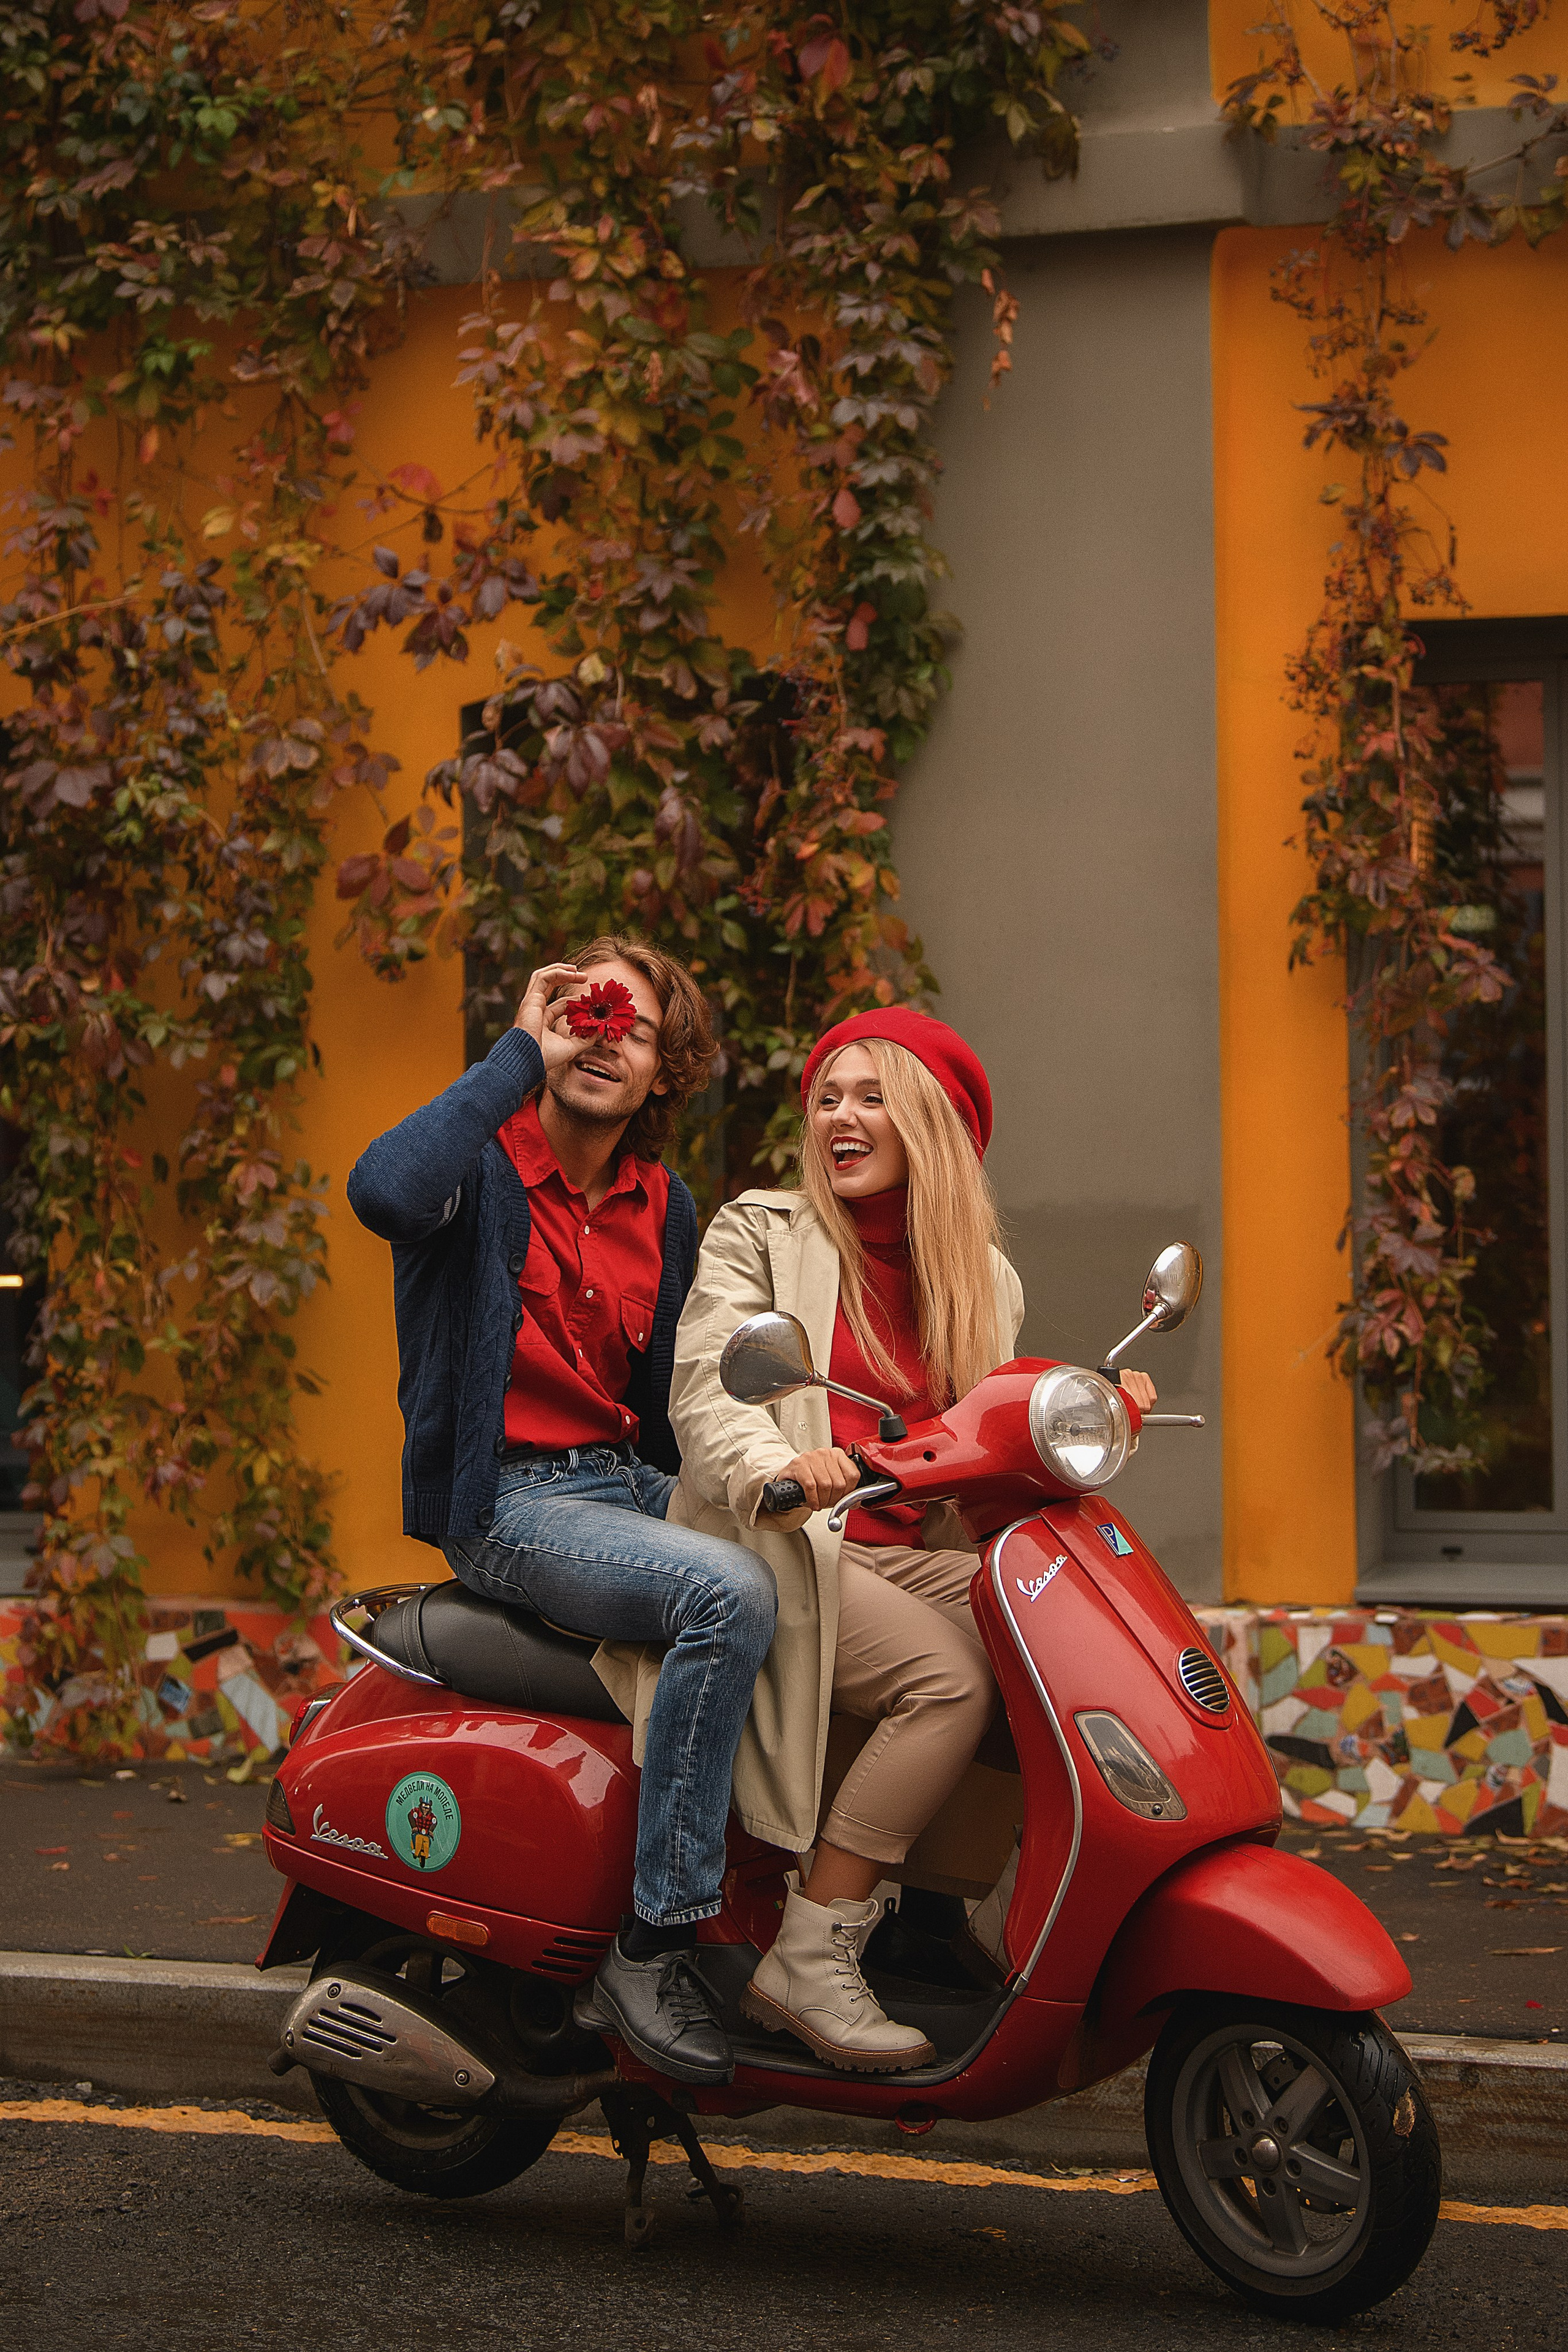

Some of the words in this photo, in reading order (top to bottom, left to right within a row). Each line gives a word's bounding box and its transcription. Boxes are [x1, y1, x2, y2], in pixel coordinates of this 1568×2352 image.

[1101, 1526, 1115, 1544] P
[1016, 1555, 1068, 1602] Vespa
[396, 1781, 424, 1806] МЕДВЕДИ
[426, 1782, 434, 1793] НА
[434, 1787, 453, 1820] МОПЕДЕ
[311, 1803, 389, 1860] Vespa
